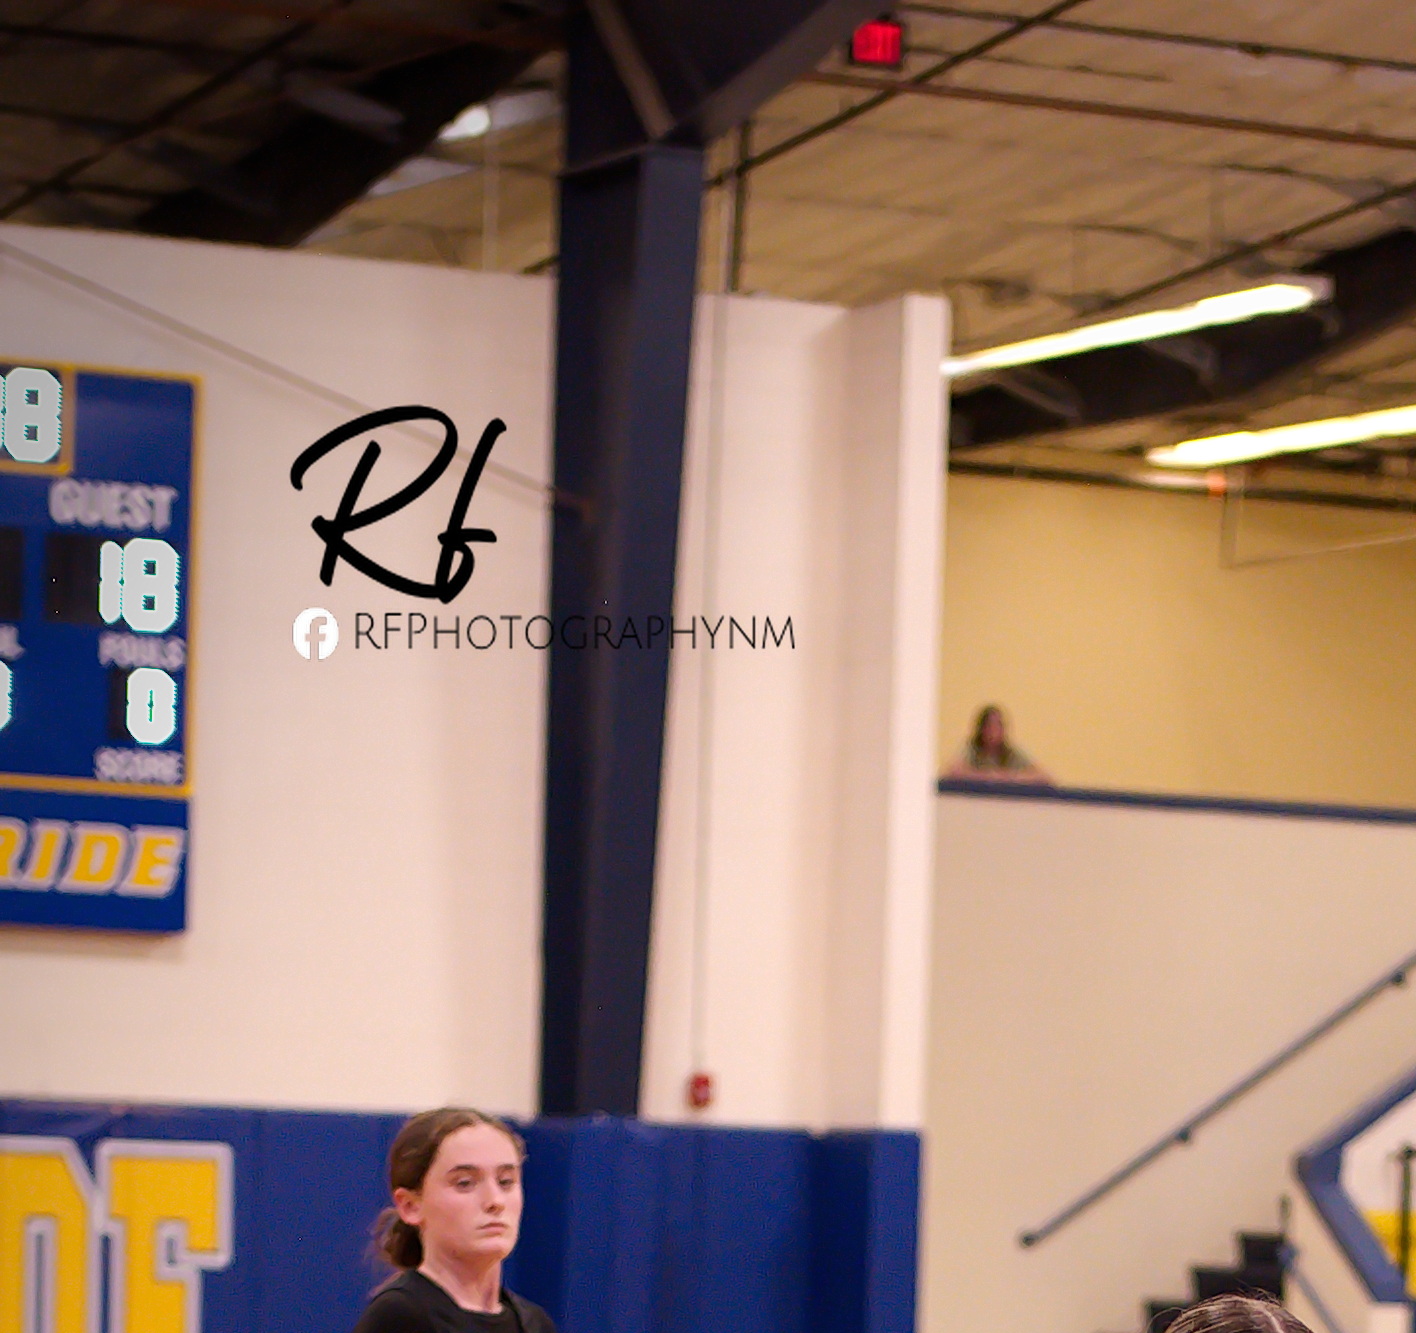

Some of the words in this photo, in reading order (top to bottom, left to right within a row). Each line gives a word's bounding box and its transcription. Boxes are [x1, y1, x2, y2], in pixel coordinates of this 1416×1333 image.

[0, 366, 62, 463] 8
[50, 479, 178, 533] GUEST
[98, 537, 182, 634] 18
